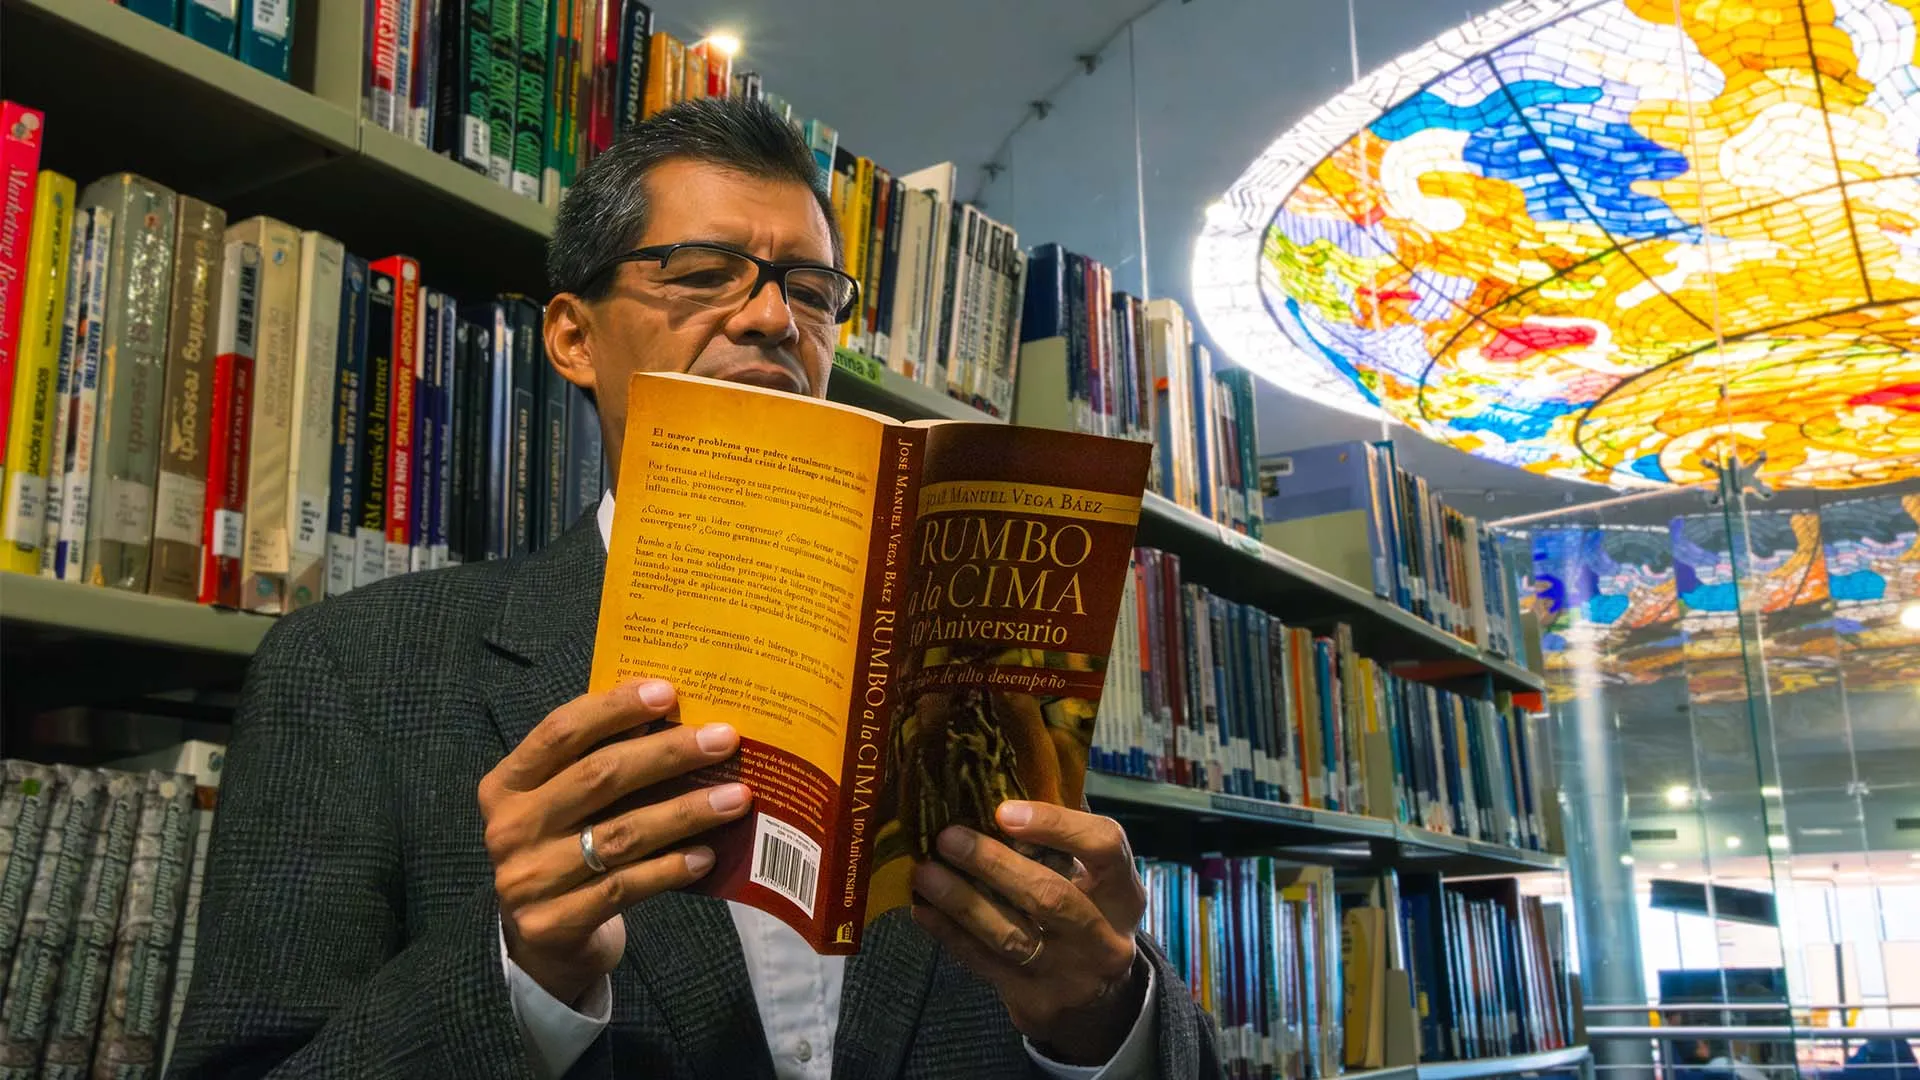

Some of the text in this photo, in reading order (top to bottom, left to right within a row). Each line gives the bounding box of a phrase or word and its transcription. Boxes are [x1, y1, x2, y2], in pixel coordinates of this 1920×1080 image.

[625, 10, 645, 124] customer
[1, 164, 28, 260] Marketing
[236, 265, 256, 346] WHY WE BUY
[56, 324, 75, 393] MARKETING
[83, 320, 101, 390] MARKETING
[349, 371, 358, 388] LO
[368, 356, 388, 419] Internet
[176, 369, 201, 462] research
[347, 389, 358, 412] QUE
[392, 280, 416, 521] ELATIONSHIP MARKETING JOHN EGAN
[346, 415, 356, 434] LES
[367, 423, 385, 441] de
[653, 427, 664, 438] El
[668, 432, 695, 442] mayor
[698, 437, 741, 450] problema
[744, 446, 760, 455] que
[763, 449, 788, 461] padece
[343, 437, 355, 473] GUSTA
[368, 444, 384, 488] través
[651, 440, 679, 450] zación
[693, 448, 710, 456] una
[712, 450, 752, 464] profunda
[755, 459, 776, 469] crisis
[778, 462, 786, 470] de
[788, 463, 819, 480] liderazgo
[343, 475, 353, 485] A
[645, 482, 688, 497] influencia
[653, 474, 822, 514] con promover el bien partiendo
[665, 464, 698, 476] fortuna
[700, 470, 706, 478] el
[708, 470, 746, 486] liderazgo
[757, 482, 771, 490] una
[341, 488, 352, 510] LOS
[949, 485, 1104, 514] MANUEL VEGA BÁEZ
[637, 535, 665, 548] Rumbo
[674, 540, 682, 552] la
[640, 516, 780, 549] convergente? garantizar el
[678, 512, 784, 538] ser un congruente?
[920, 517, 1093, 568] RUMBO
[636, 546, 654, 558] base
[671, 552, 684, 562] los
[738, 566, 776, 582] principios
[778, 576, 788, 584] de
[790, 578, 818, 596] liderazgo
[672, 566, 783, 596] una emocionante narración
[688, 578, 698, 587] de
[700, 582, 743, 598] aplicación
[908, 563, 1088, 617] a la CIMA
[631, 579, 674, 594] desarrollo
[676, 588, 727, 604] permanente
[728, 597, 739, 606] de
[741, 600, 748, 609] la
[750, 603, 784, 619] capacidad
[785, 614, 794, 622] de
[623, 634, 689, 651] mos hablando?
[624, 623, 664, 636] excelente
[666, 631, 698, 642] manera
[700, 635, 710, 645] de
[711, 639, 753, 654] contribuir
[760, 652, 788, 665] atenuar
[660, 617, 669, 626] el
[672, 620, 750, 642] perfeccionamiento
[754, 636, 765, 646] del
[768, 640, 799, 658] liderazgo
[929, 612, 1068, 645] Aniversario
[620, 654, 630, 664] Lo
[678, 666, 692, 677] que
[720, 672, 728, 682] el
[681, 678, 700, 688] obra
[708, 683, 738, 698] propone
[843, 438, 912, 908] JOSÉ MANUEL VEGA BÁEZ RUMBO a la CIMA Aniversario
[941, 667, 954, 684] de
[957, 666, 985, 683] alto
[987, 667, 1066, 692] desempeño
[1, 796, 41, 917] Comportamiento
[22, 798, 87, 1036] Comportamiento del consumidor
[73, 799, 131, 1036] Comportamiento del consumidor
[138, 802, 182, 1035] Comportamiento del consumidor
